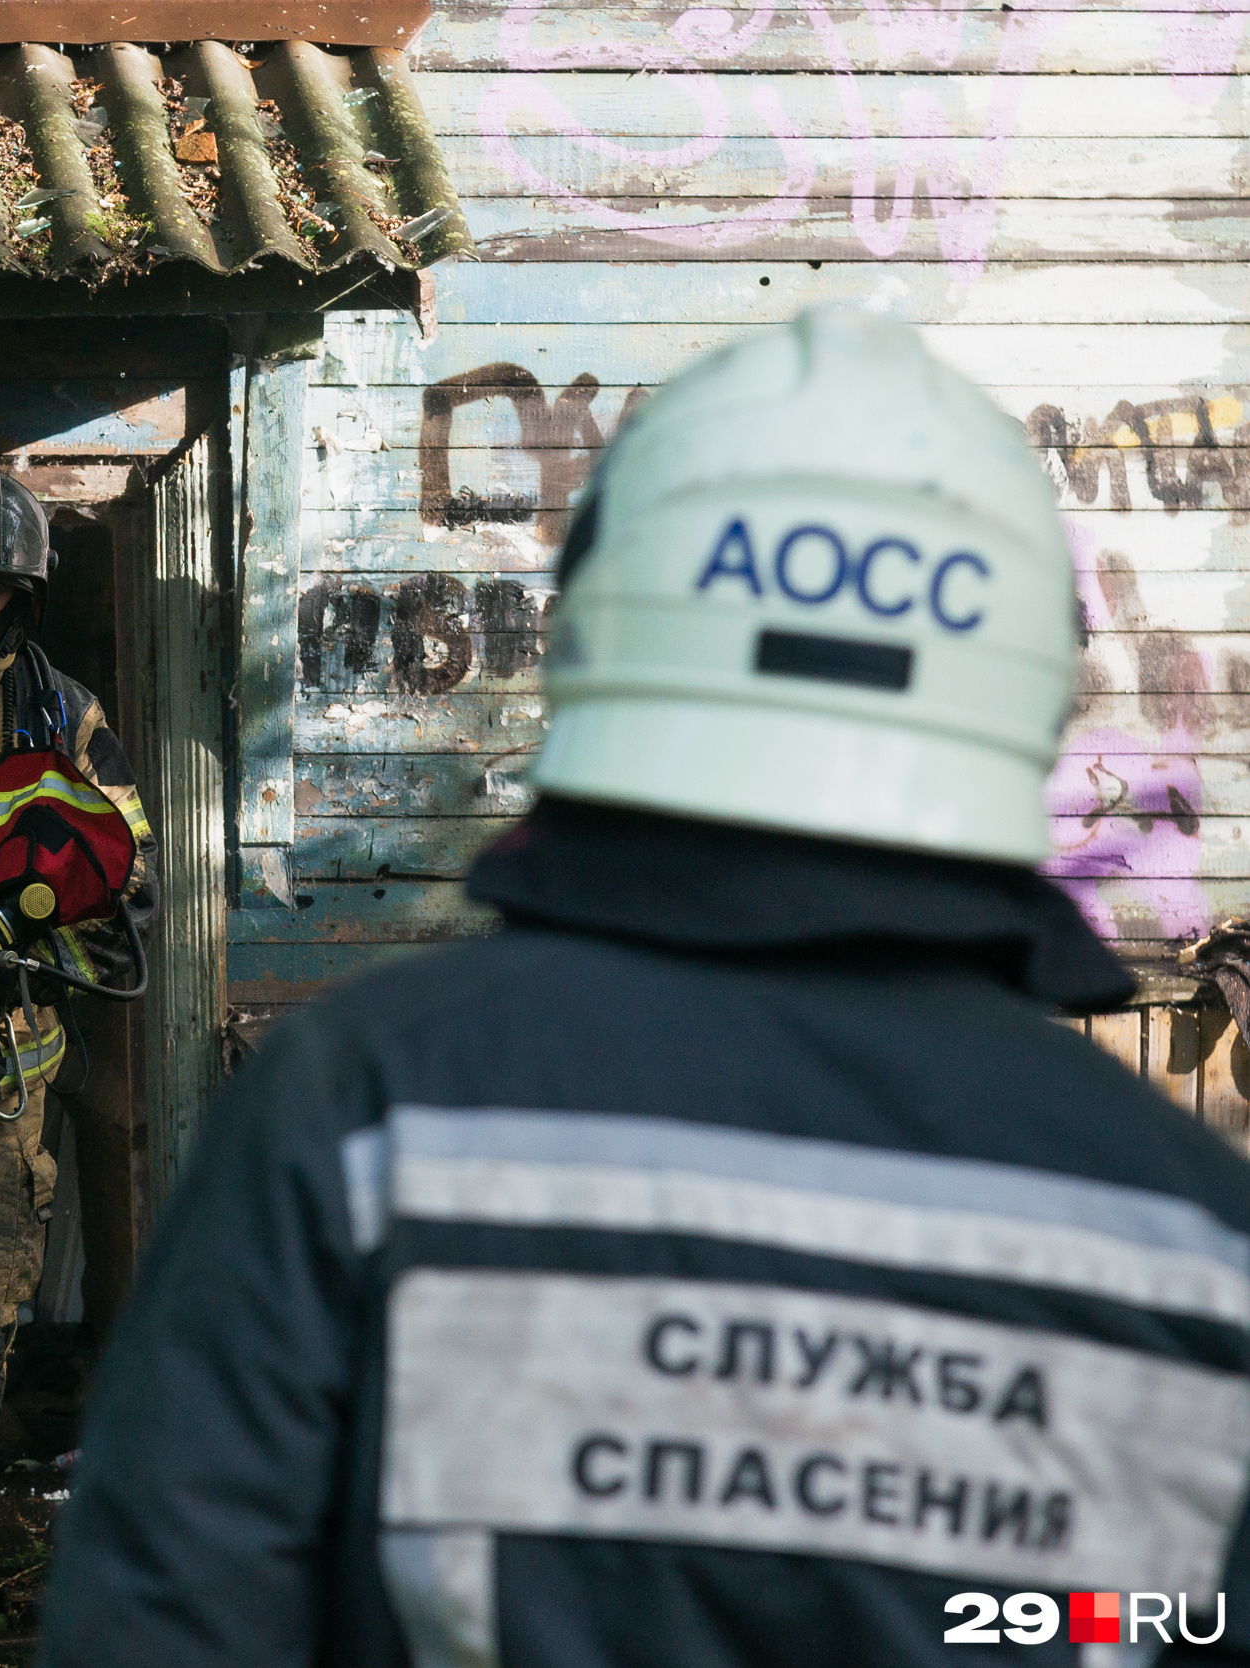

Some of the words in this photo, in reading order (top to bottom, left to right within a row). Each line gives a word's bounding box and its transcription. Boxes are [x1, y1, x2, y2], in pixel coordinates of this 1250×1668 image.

[695, 512, 992, 632] АОСС
[644, 1312, 1049, 1432] СЛУЖБА
[571, 1429, 1075, 1553] СПАСЕНИЯ
